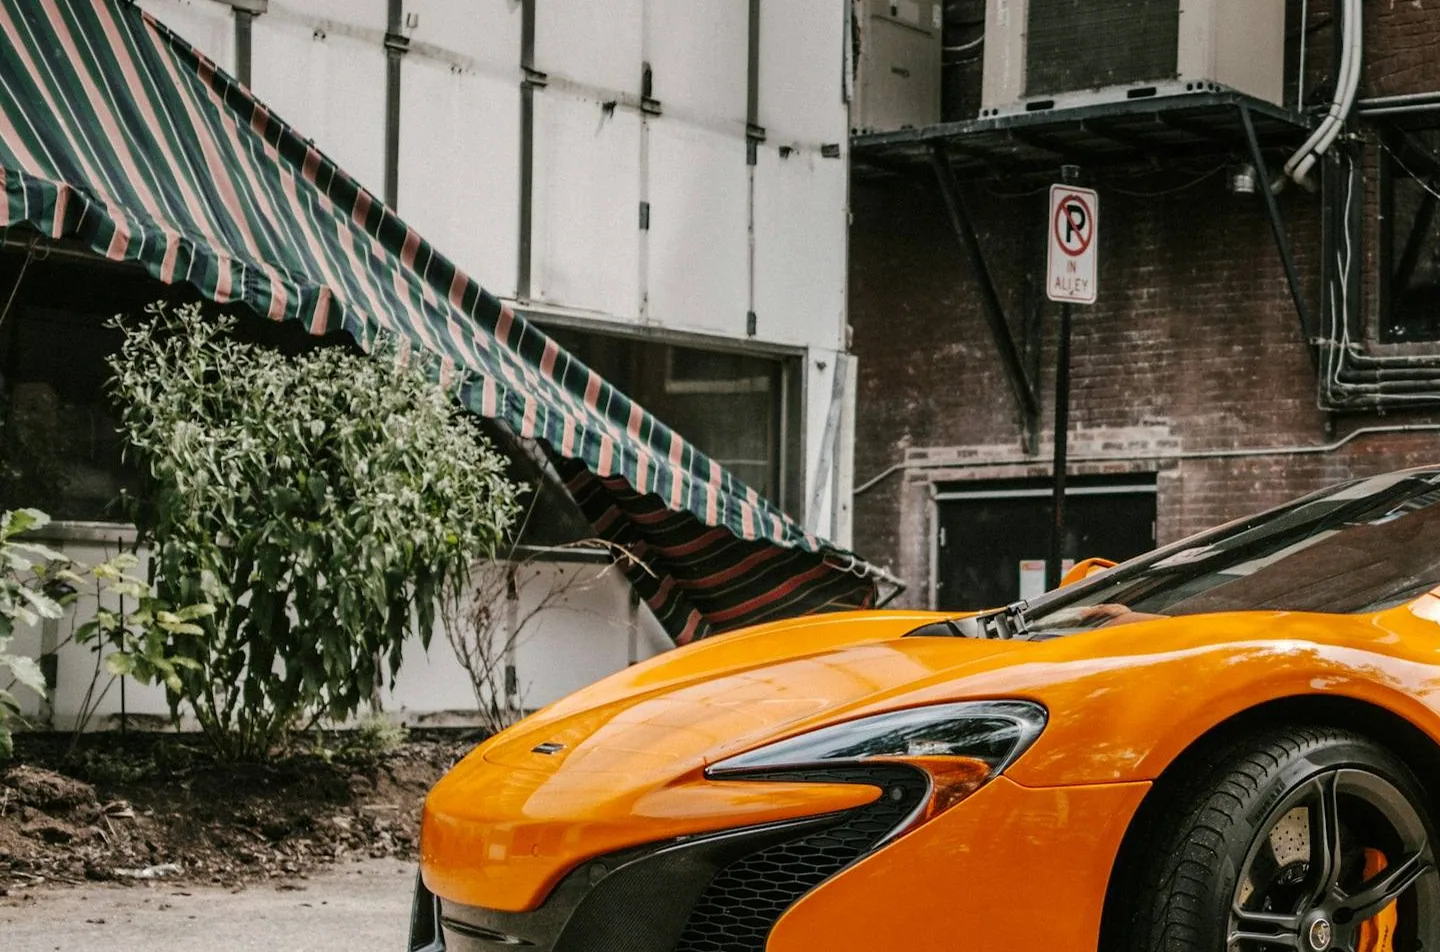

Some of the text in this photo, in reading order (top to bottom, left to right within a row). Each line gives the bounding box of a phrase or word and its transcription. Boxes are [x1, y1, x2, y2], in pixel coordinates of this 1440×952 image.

[1066, 204, 1086, 243] P
[1066, 260, 1077, 273] IN
[1055, 276, 1088, 292] ALLEY
